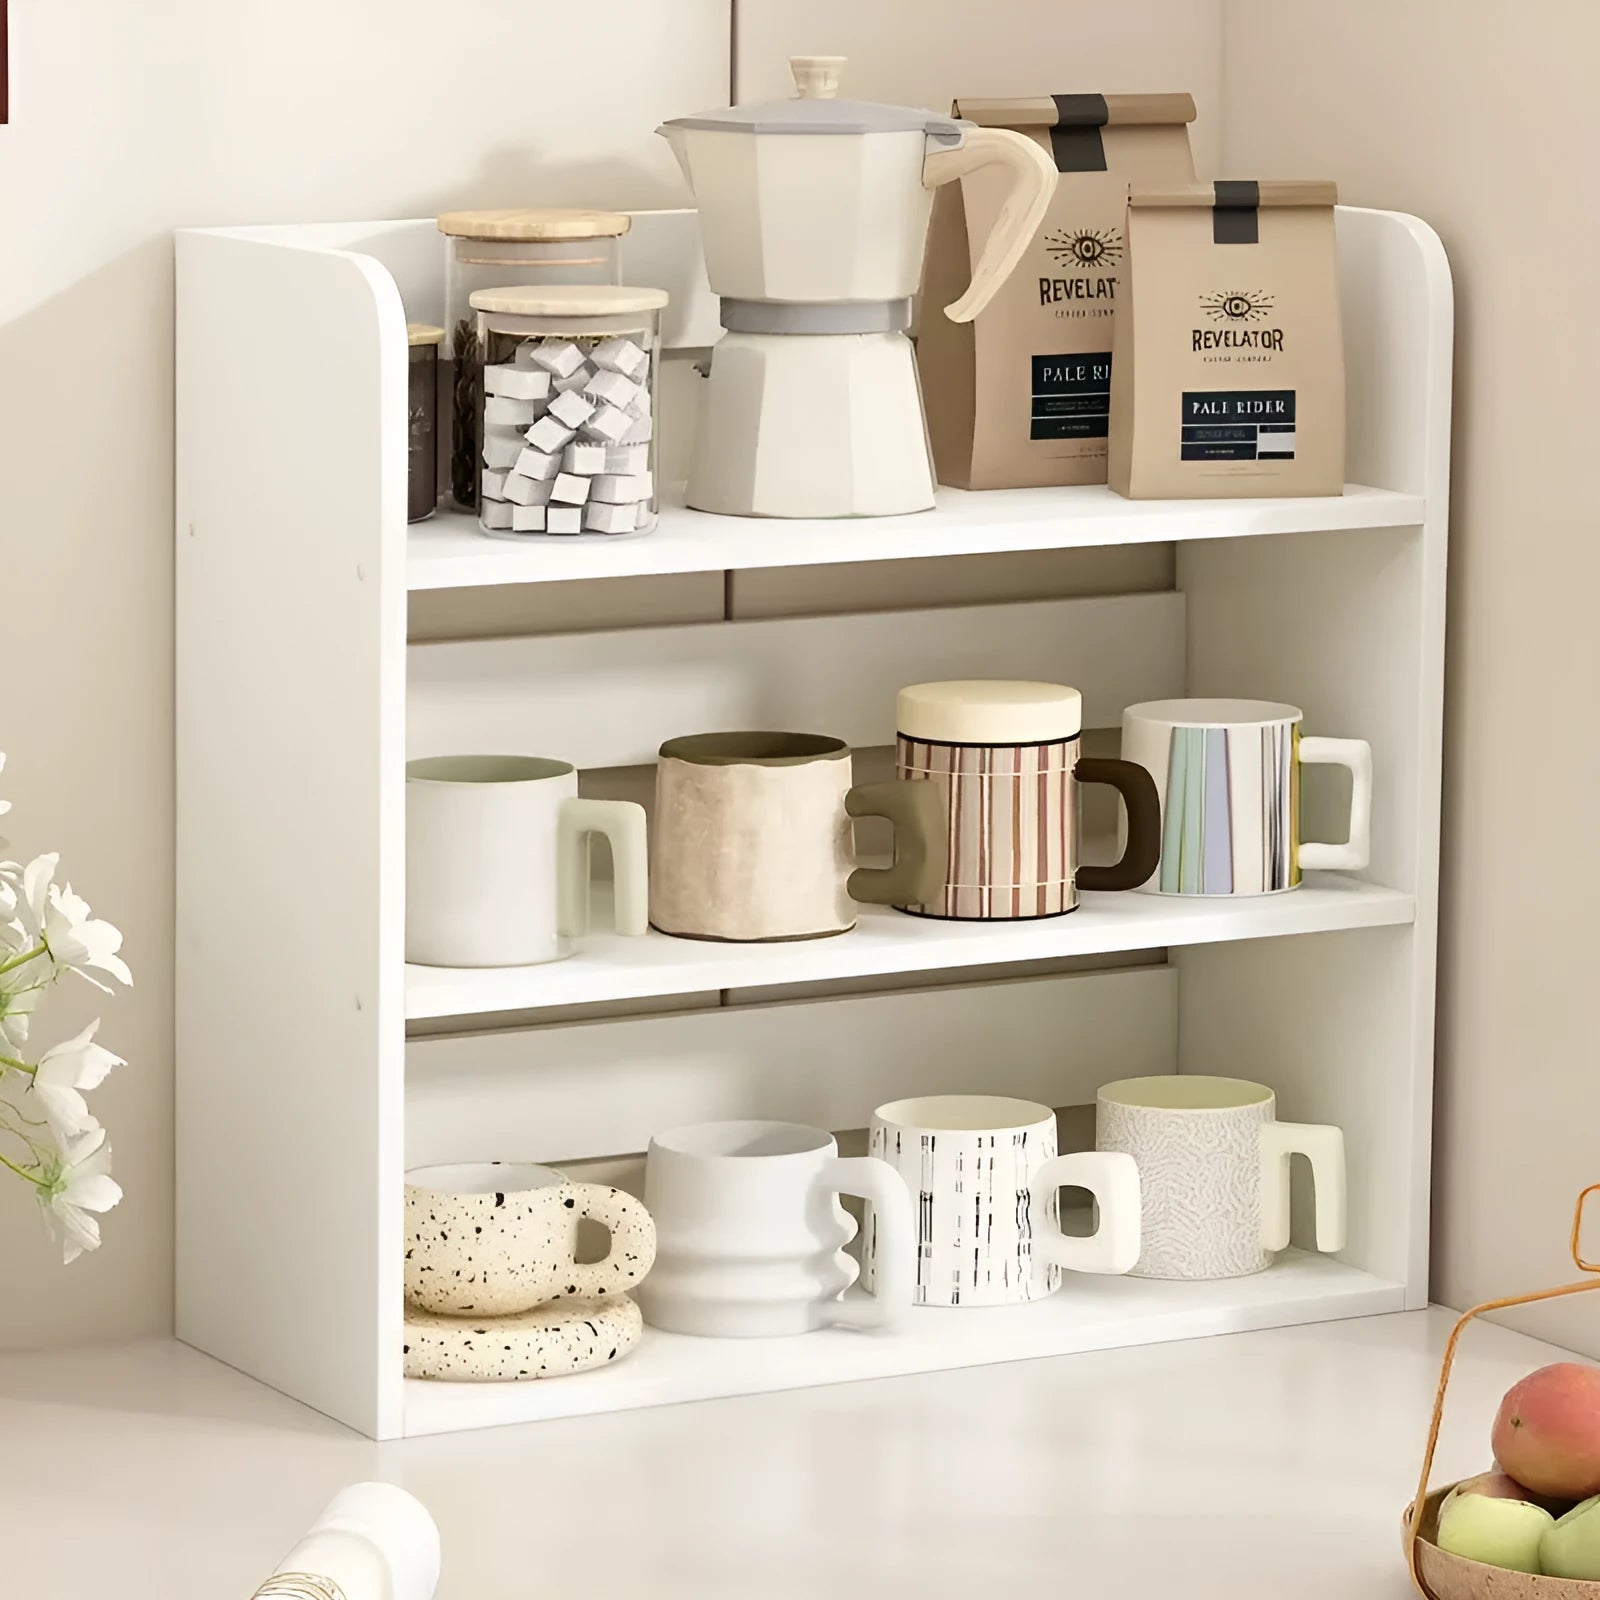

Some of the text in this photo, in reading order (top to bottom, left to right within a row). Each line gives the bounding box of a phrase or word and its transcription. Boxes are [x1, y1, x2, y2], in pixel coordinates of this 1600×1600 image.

[1039, 277, 1118, 306] REVELAT
[1192, 328, 1284, 352] REVELATOR
[1043, 364, 1109, 382] PALE RI
[1236, 400, 1285, 413] RIDER
